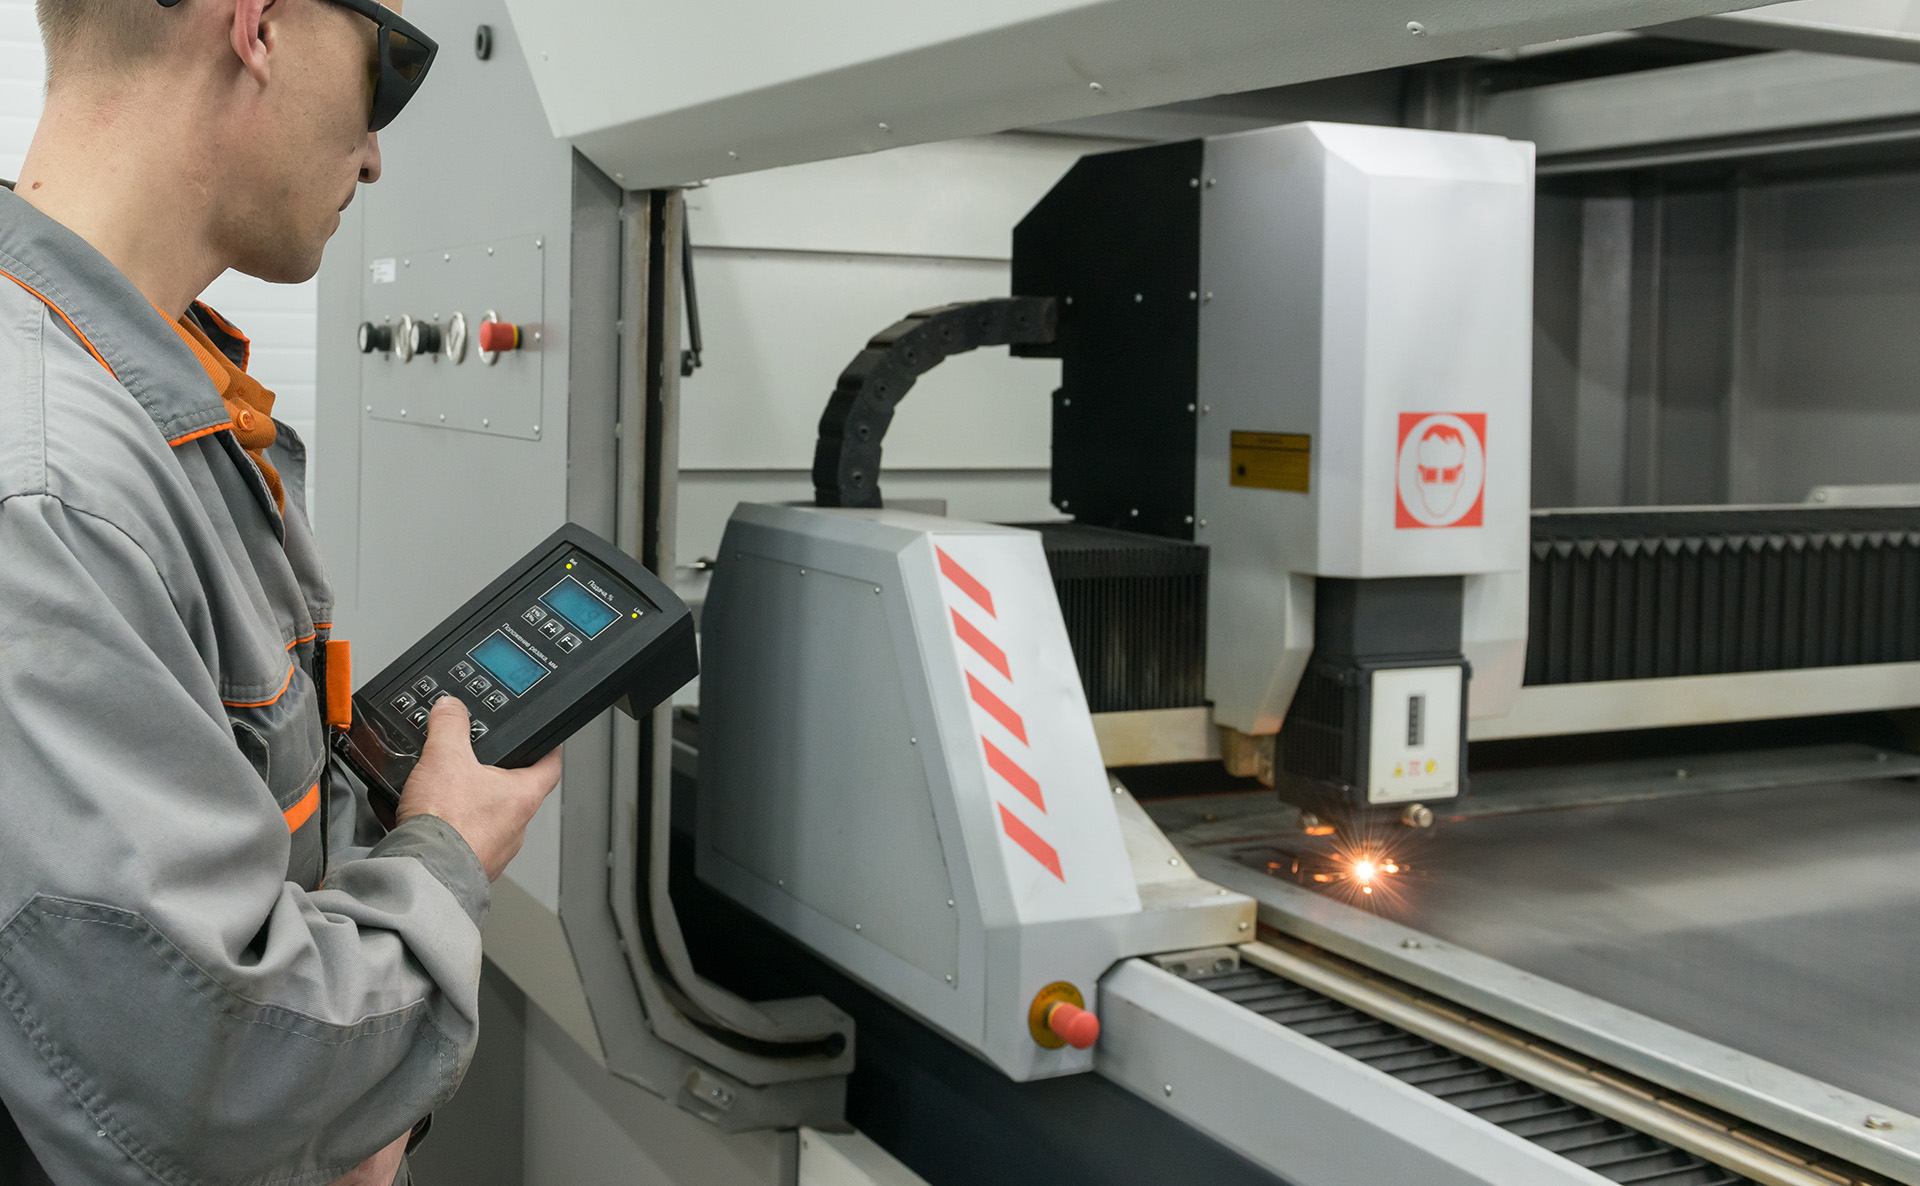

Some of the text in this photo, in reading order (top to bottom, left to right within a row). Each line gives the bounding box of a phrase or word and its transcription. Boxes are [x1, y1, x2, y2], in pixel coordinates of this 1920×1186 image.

[543, 622, 556, 634] F+
[418, 679, 431, 692] Газ
[396, 696, 410, 708] F1
